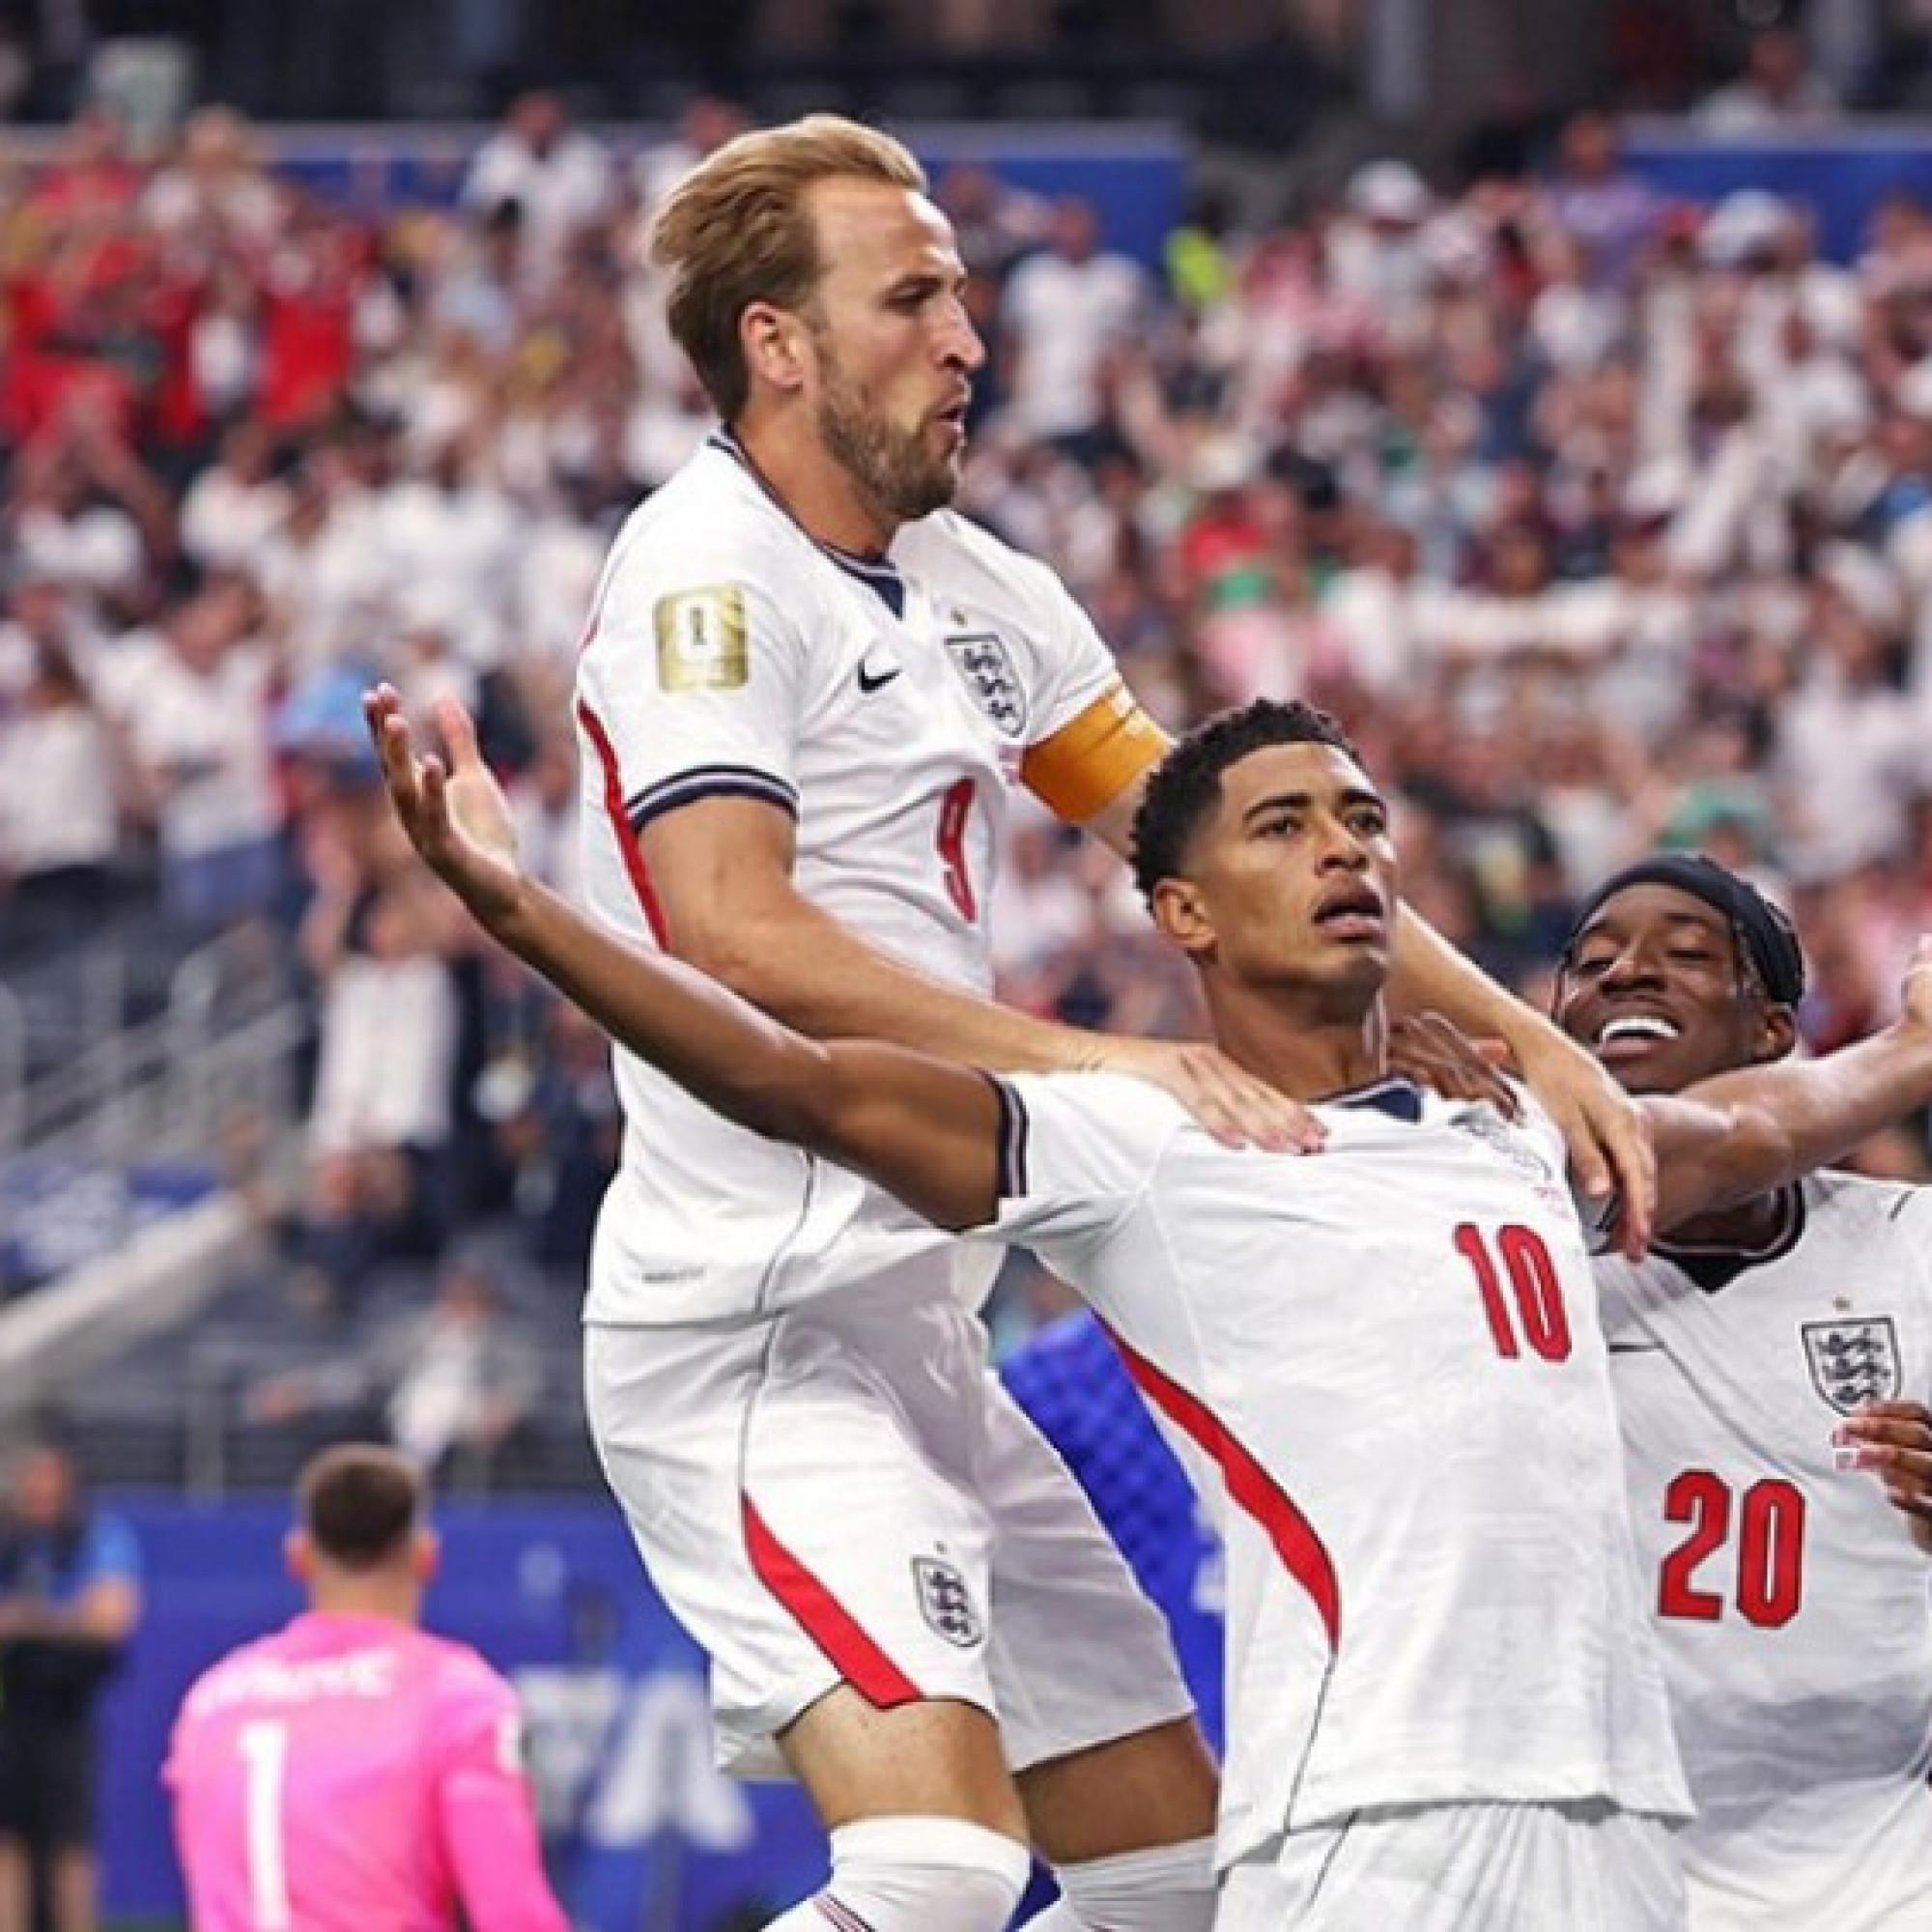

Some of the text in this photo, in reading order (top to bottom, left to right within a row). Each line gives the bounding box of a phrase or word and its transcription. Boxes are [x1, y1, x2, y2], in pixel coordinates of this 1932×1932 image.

[935, 775, 979, 924] 9
[1453, 1222, 1572, 1363] 10
[1658, 1468, 1806, 1630] 20
[238, 1720, 289, 1932] 1
